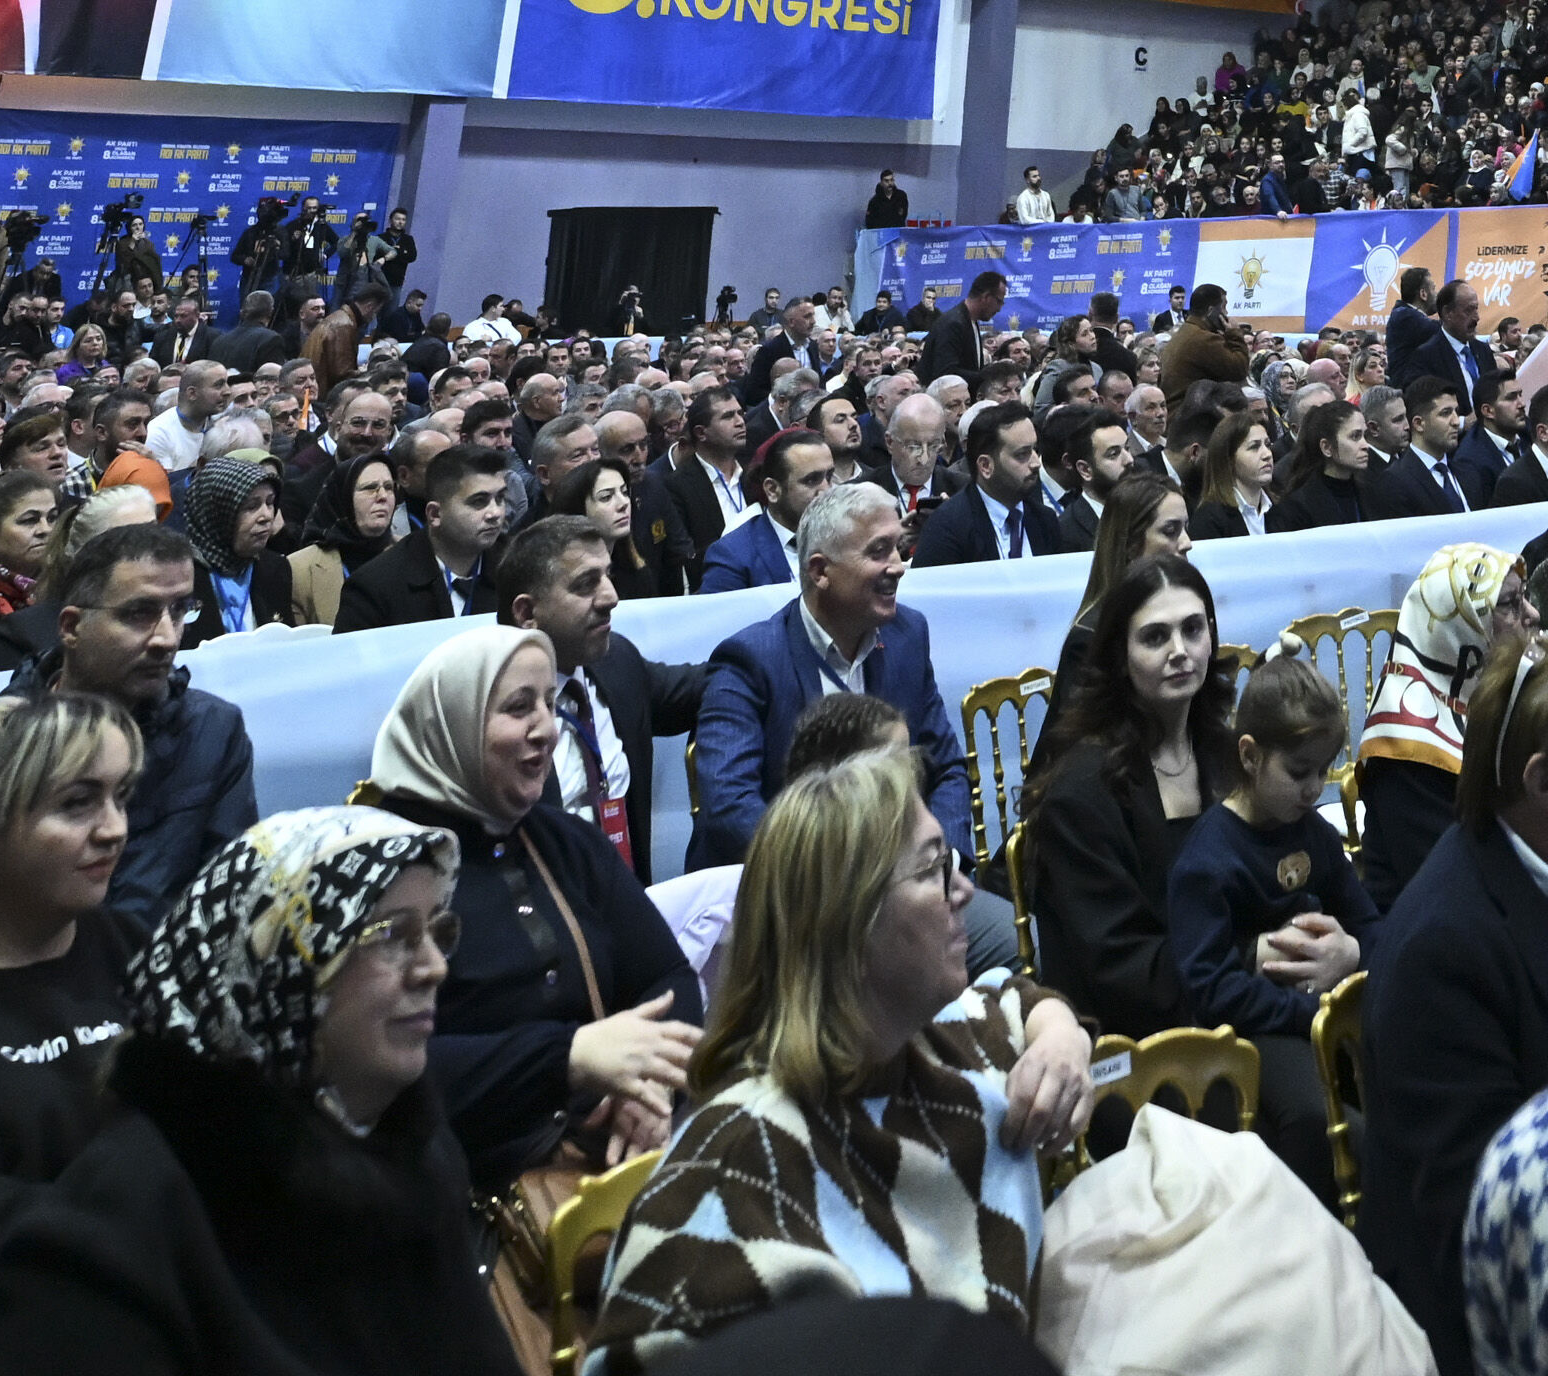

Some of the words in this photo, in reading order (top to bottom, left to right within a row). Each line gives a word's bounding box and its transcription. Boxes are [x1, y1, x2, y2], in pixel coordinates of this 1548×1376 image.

[1134, 47, 1148, 66] C
[1464, 259, 1537, 283] SÖZÜMÜZ
[1483, 282, 1512, 307] VAR
